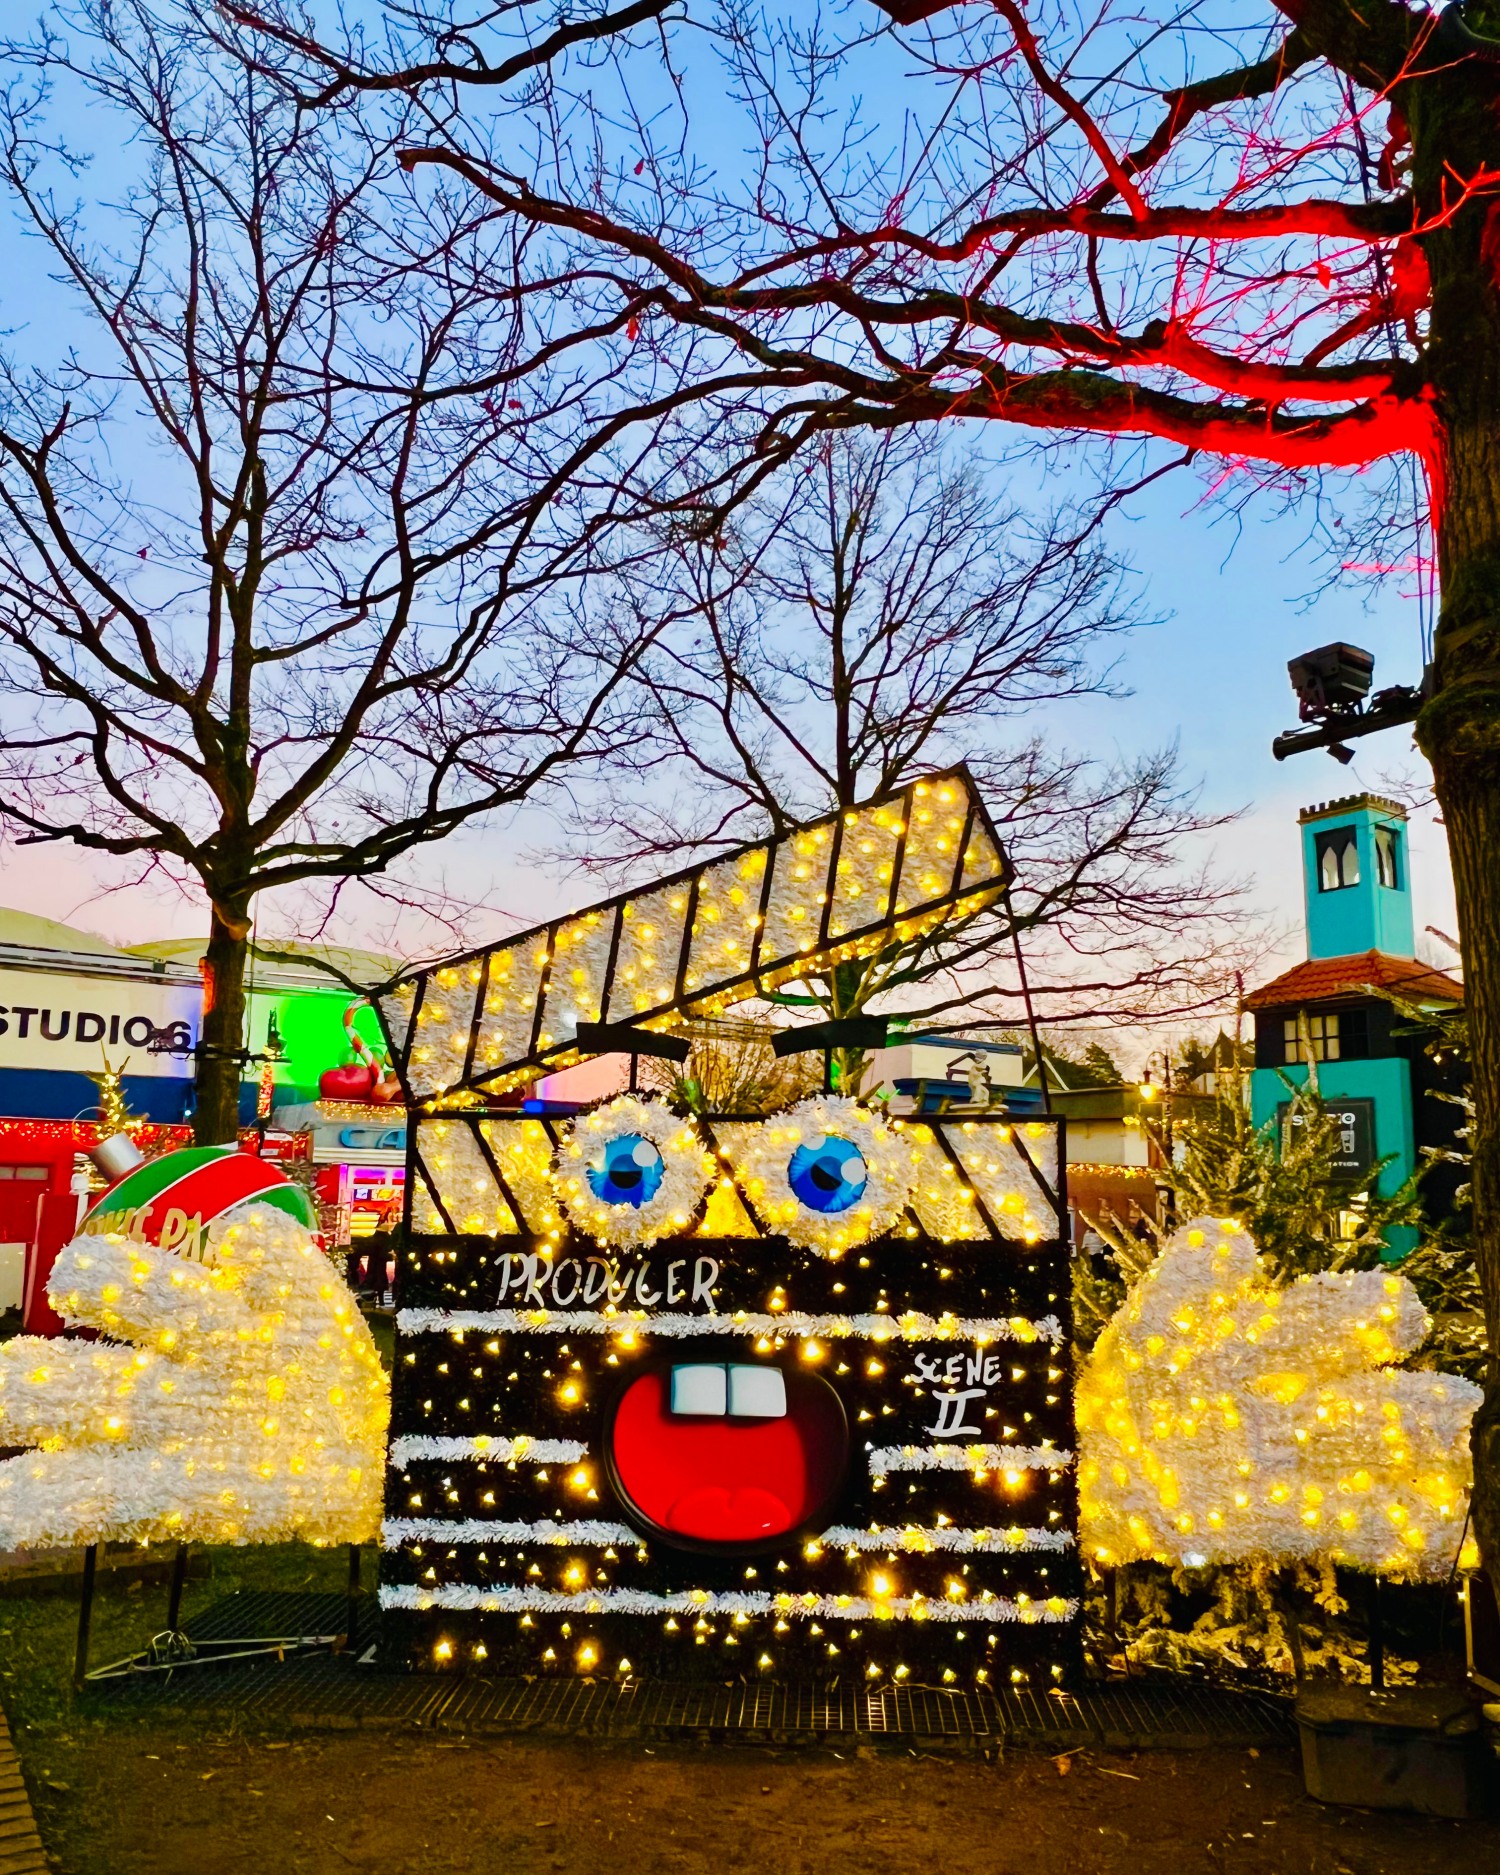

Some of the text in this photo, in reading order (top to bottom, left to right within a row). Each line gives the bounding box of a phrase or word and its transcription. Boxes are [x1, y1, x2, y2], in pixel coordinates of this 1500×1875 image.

[167, 1020, 192, 1050] 6
[494, 1252, 719, 1312] PRODUCER
[910, 1347, 1002, 1386] SCENE
[922, 1388, 988, 1437] II
